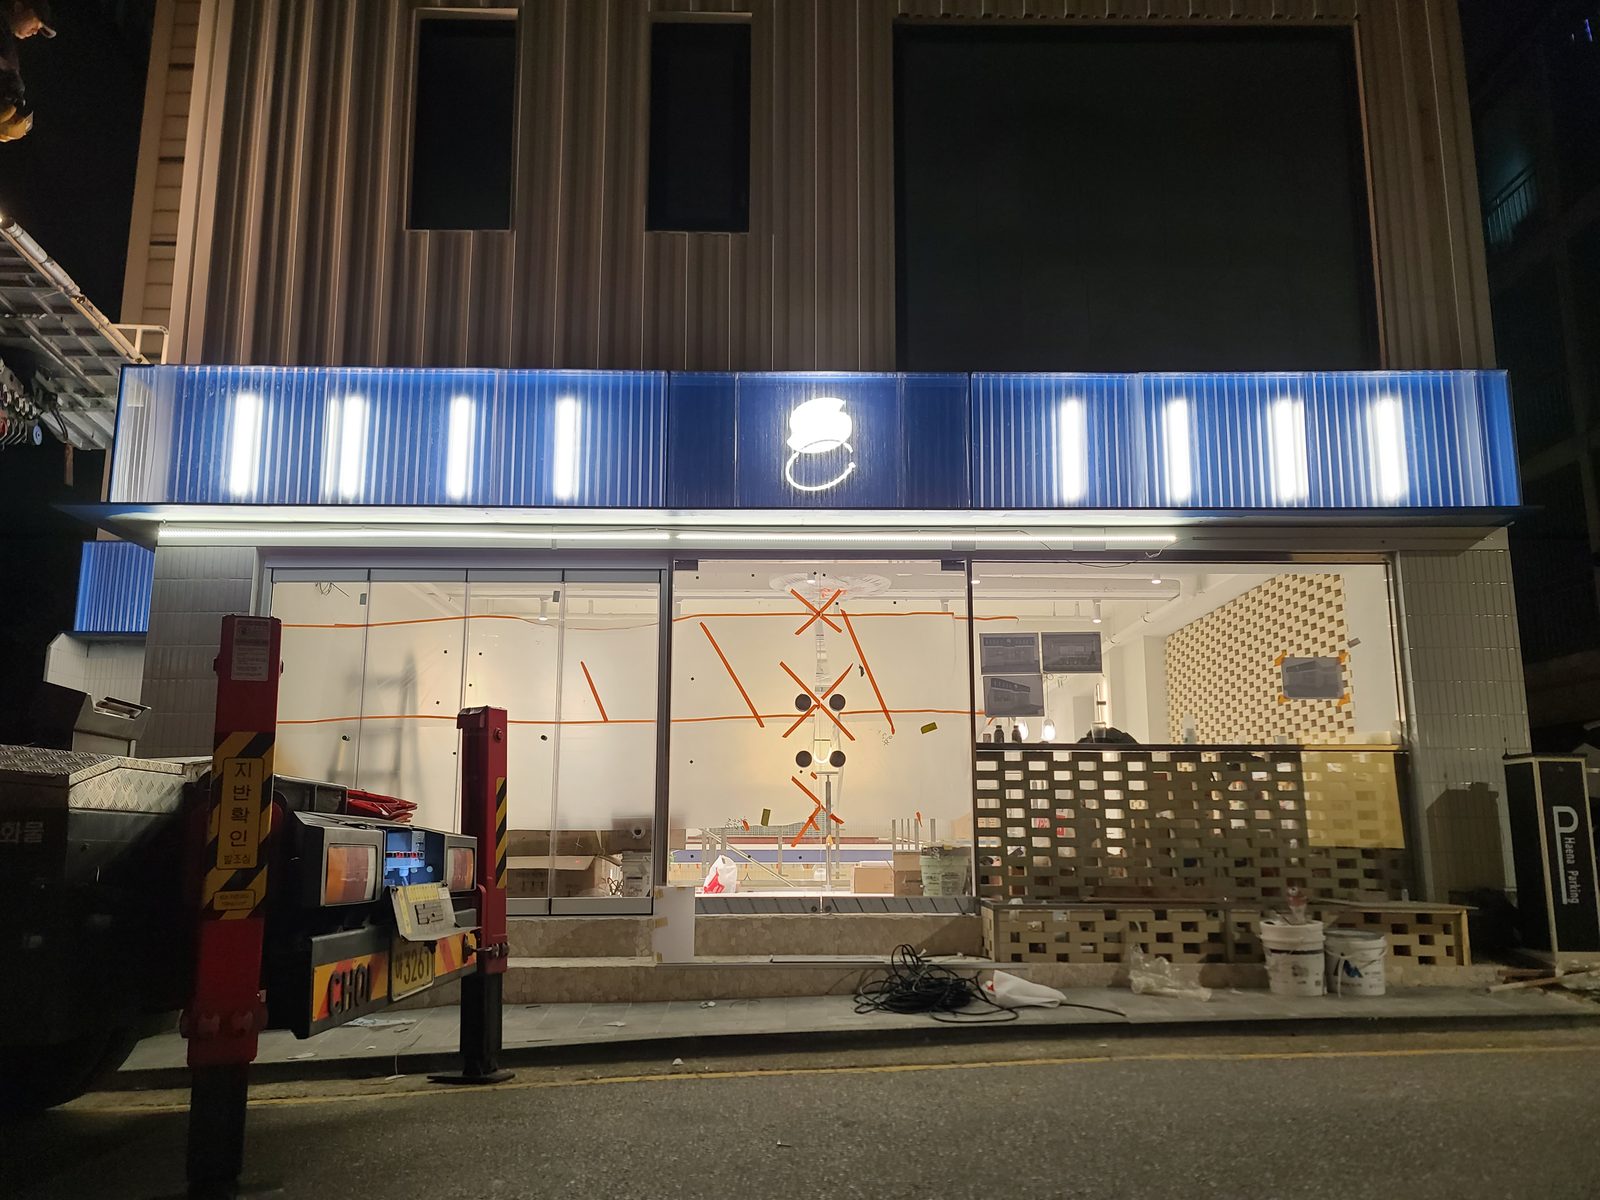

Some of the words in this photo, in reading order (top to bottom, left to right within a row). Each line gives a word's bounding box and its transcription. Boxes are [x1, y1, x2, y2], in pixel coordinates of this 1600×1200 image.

[229, 762, 252, 848] 지반확인
[0, 821, 43, 844] 화물
[1552, 805, 1579, 905] P
[1563, 837, 1576, 865] Haena
[1566, 870, 1581, 904] Parking
